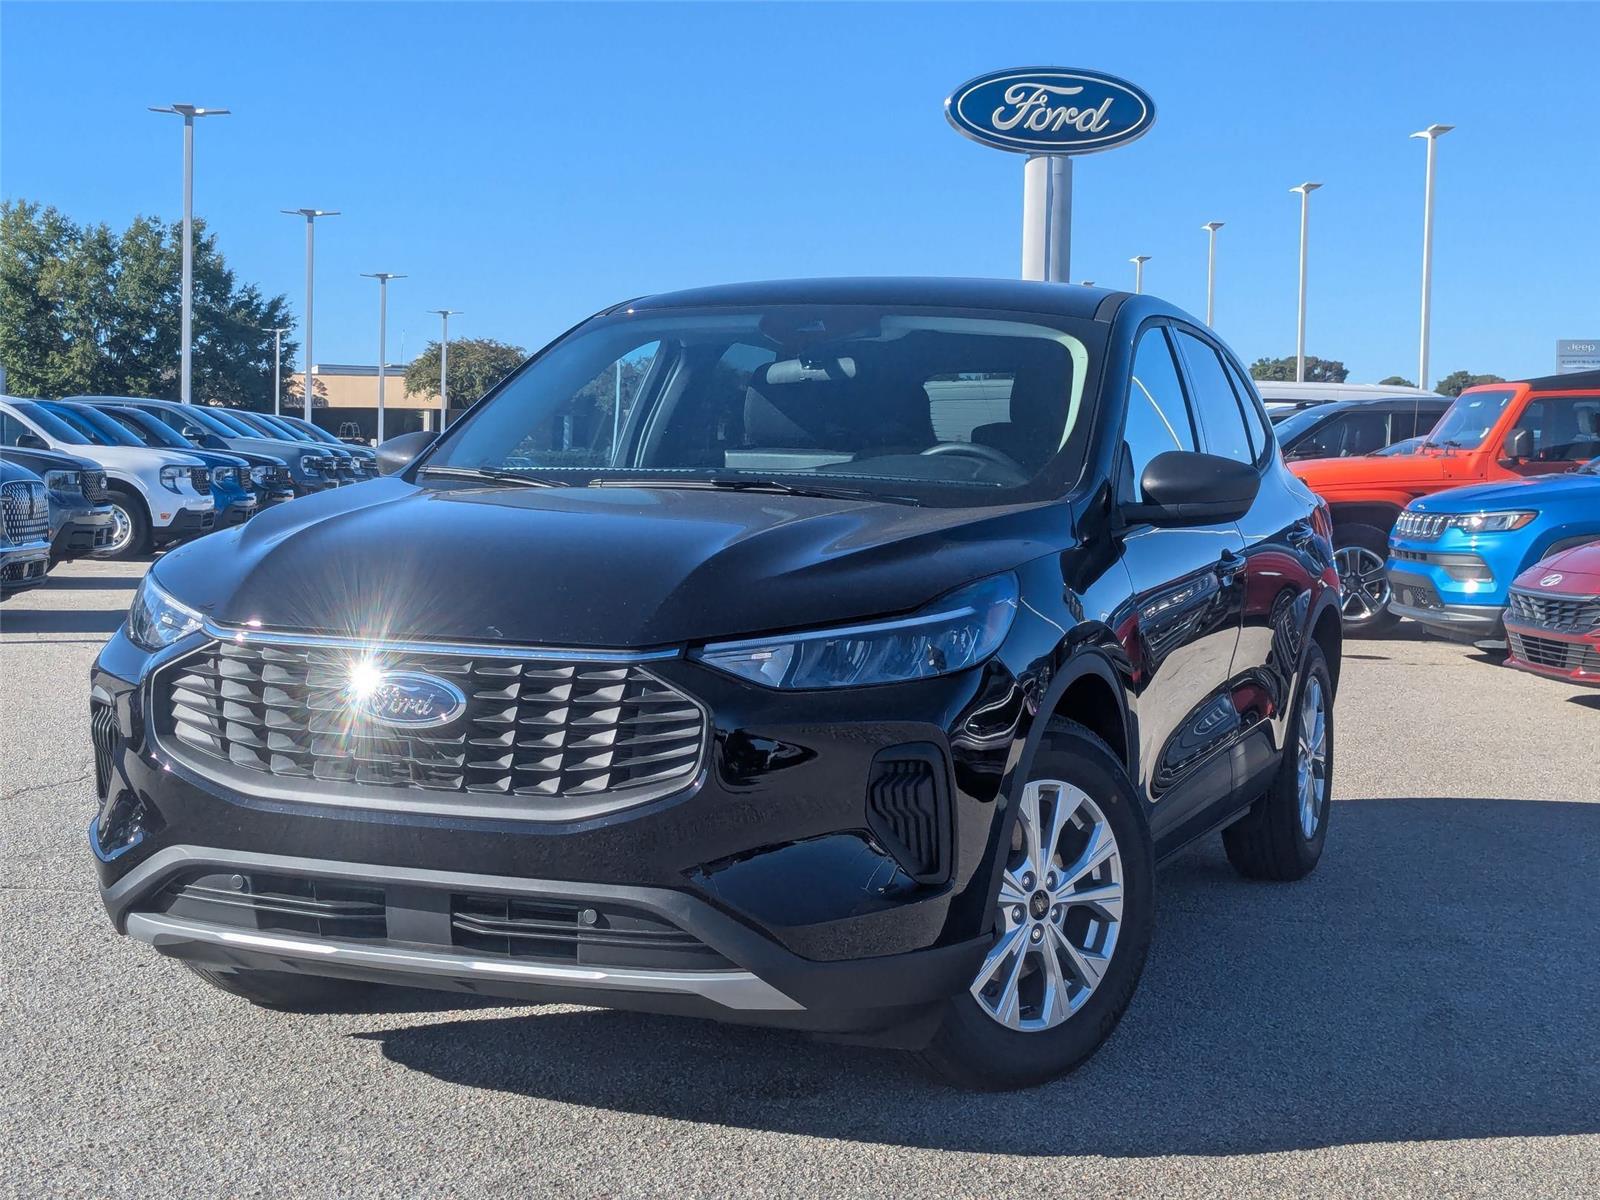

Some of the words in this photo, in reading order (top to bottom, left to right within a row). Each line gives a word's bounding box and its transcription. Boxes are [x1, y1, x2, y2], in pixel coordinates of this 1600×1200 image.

[992, 83, 1114, 132] Ford
[1567, 343, 1596, 353] Jeep
[371, 683, 435, 716] Ford
